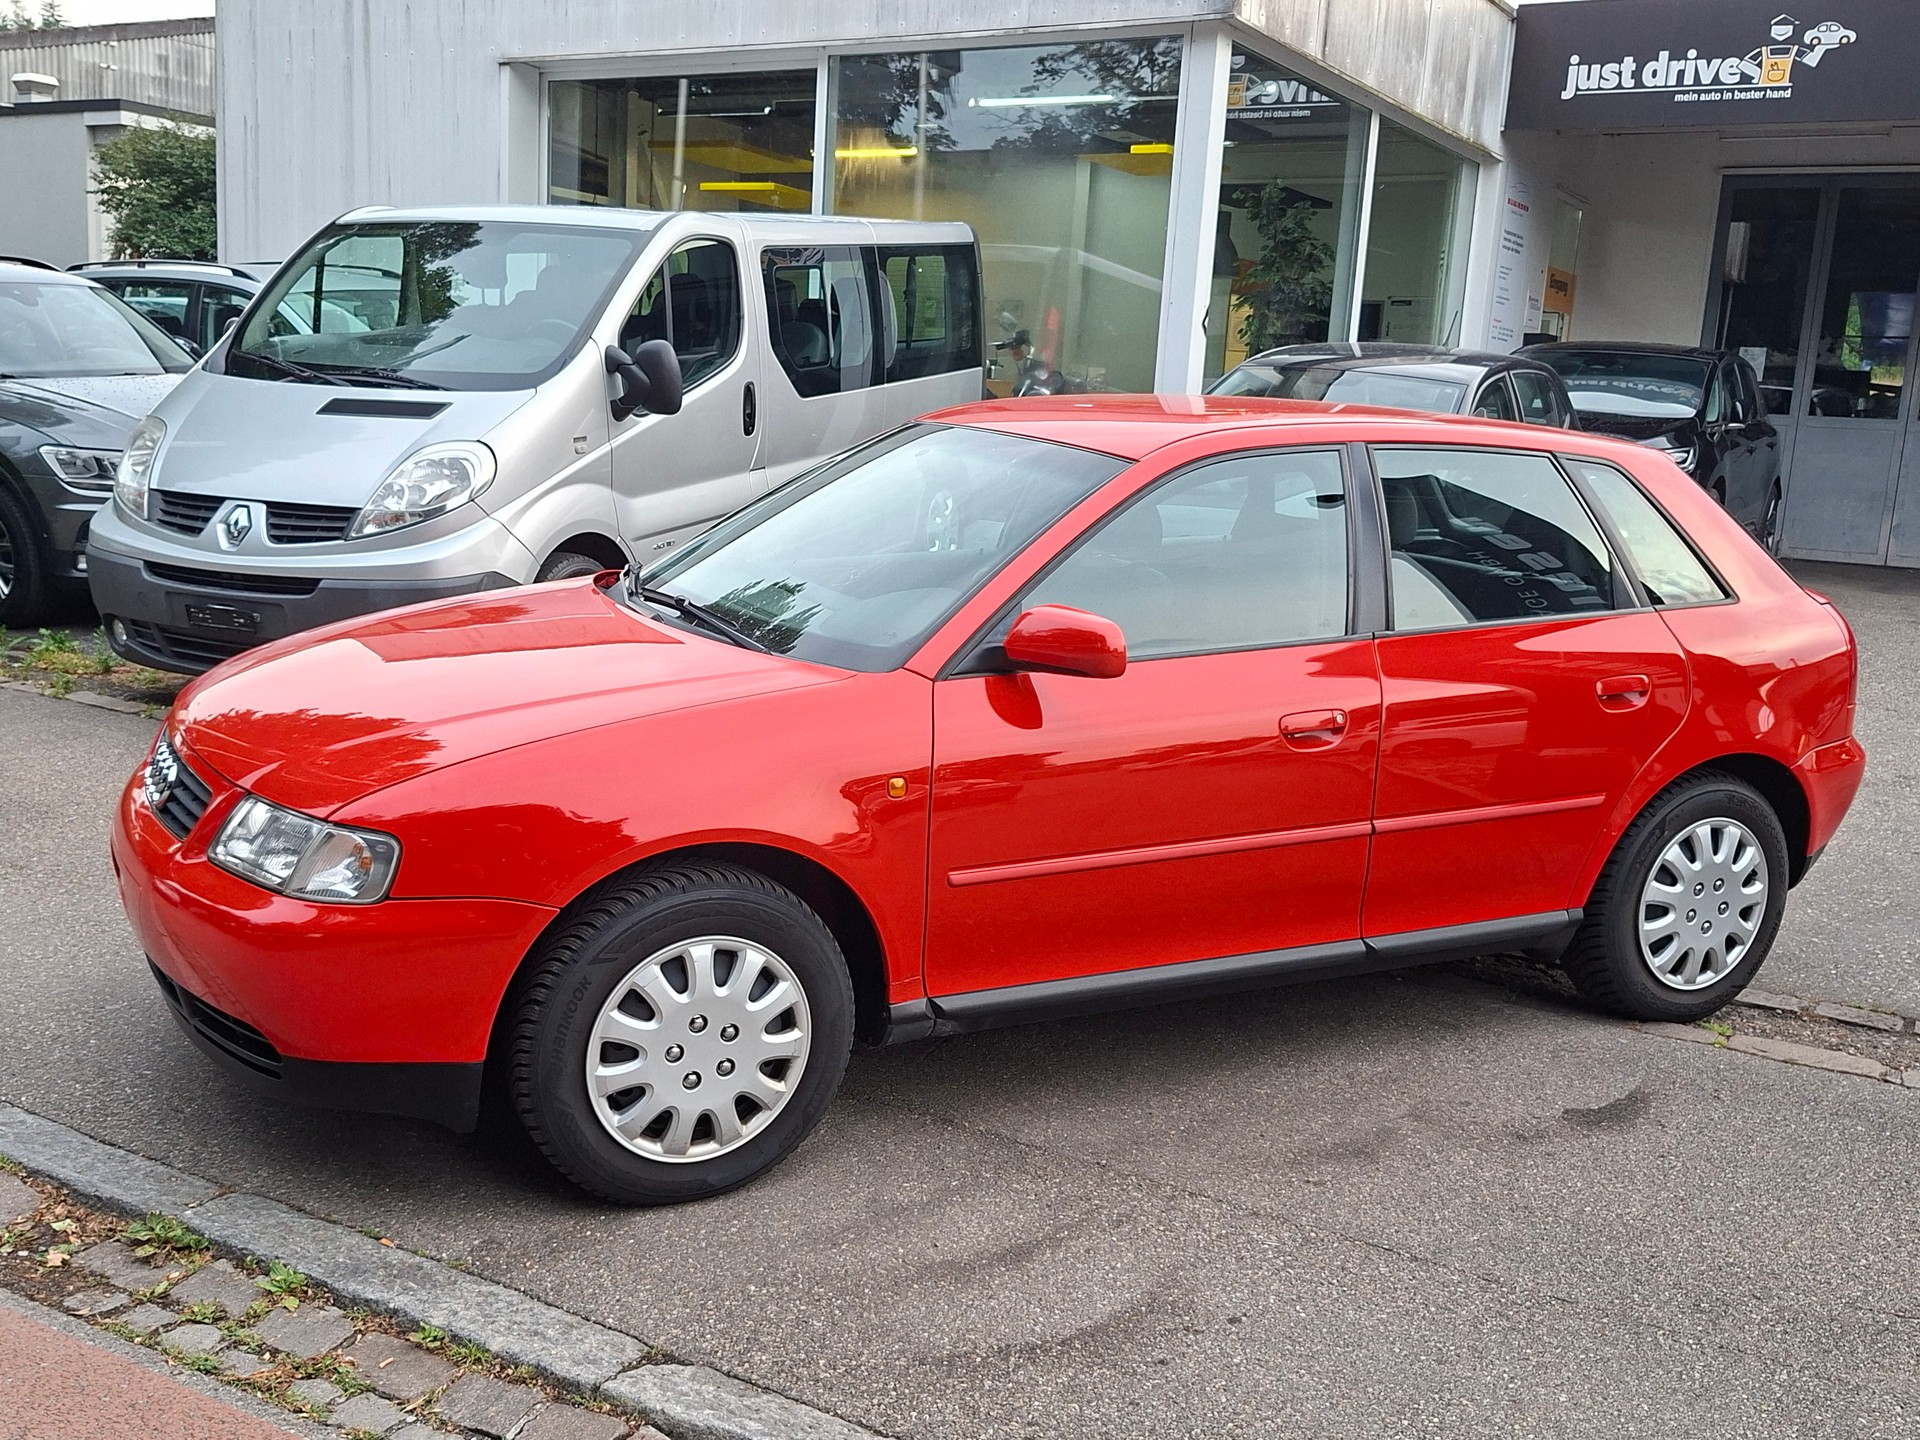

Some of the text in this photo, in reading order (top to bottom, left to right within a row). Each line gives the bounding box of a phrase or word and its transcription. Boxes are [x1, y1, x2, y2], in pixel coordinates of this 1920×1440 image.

[1561, 48, 1742, 100] just drive
[1674, 88, 1792, 102] mein auto in bester hand
